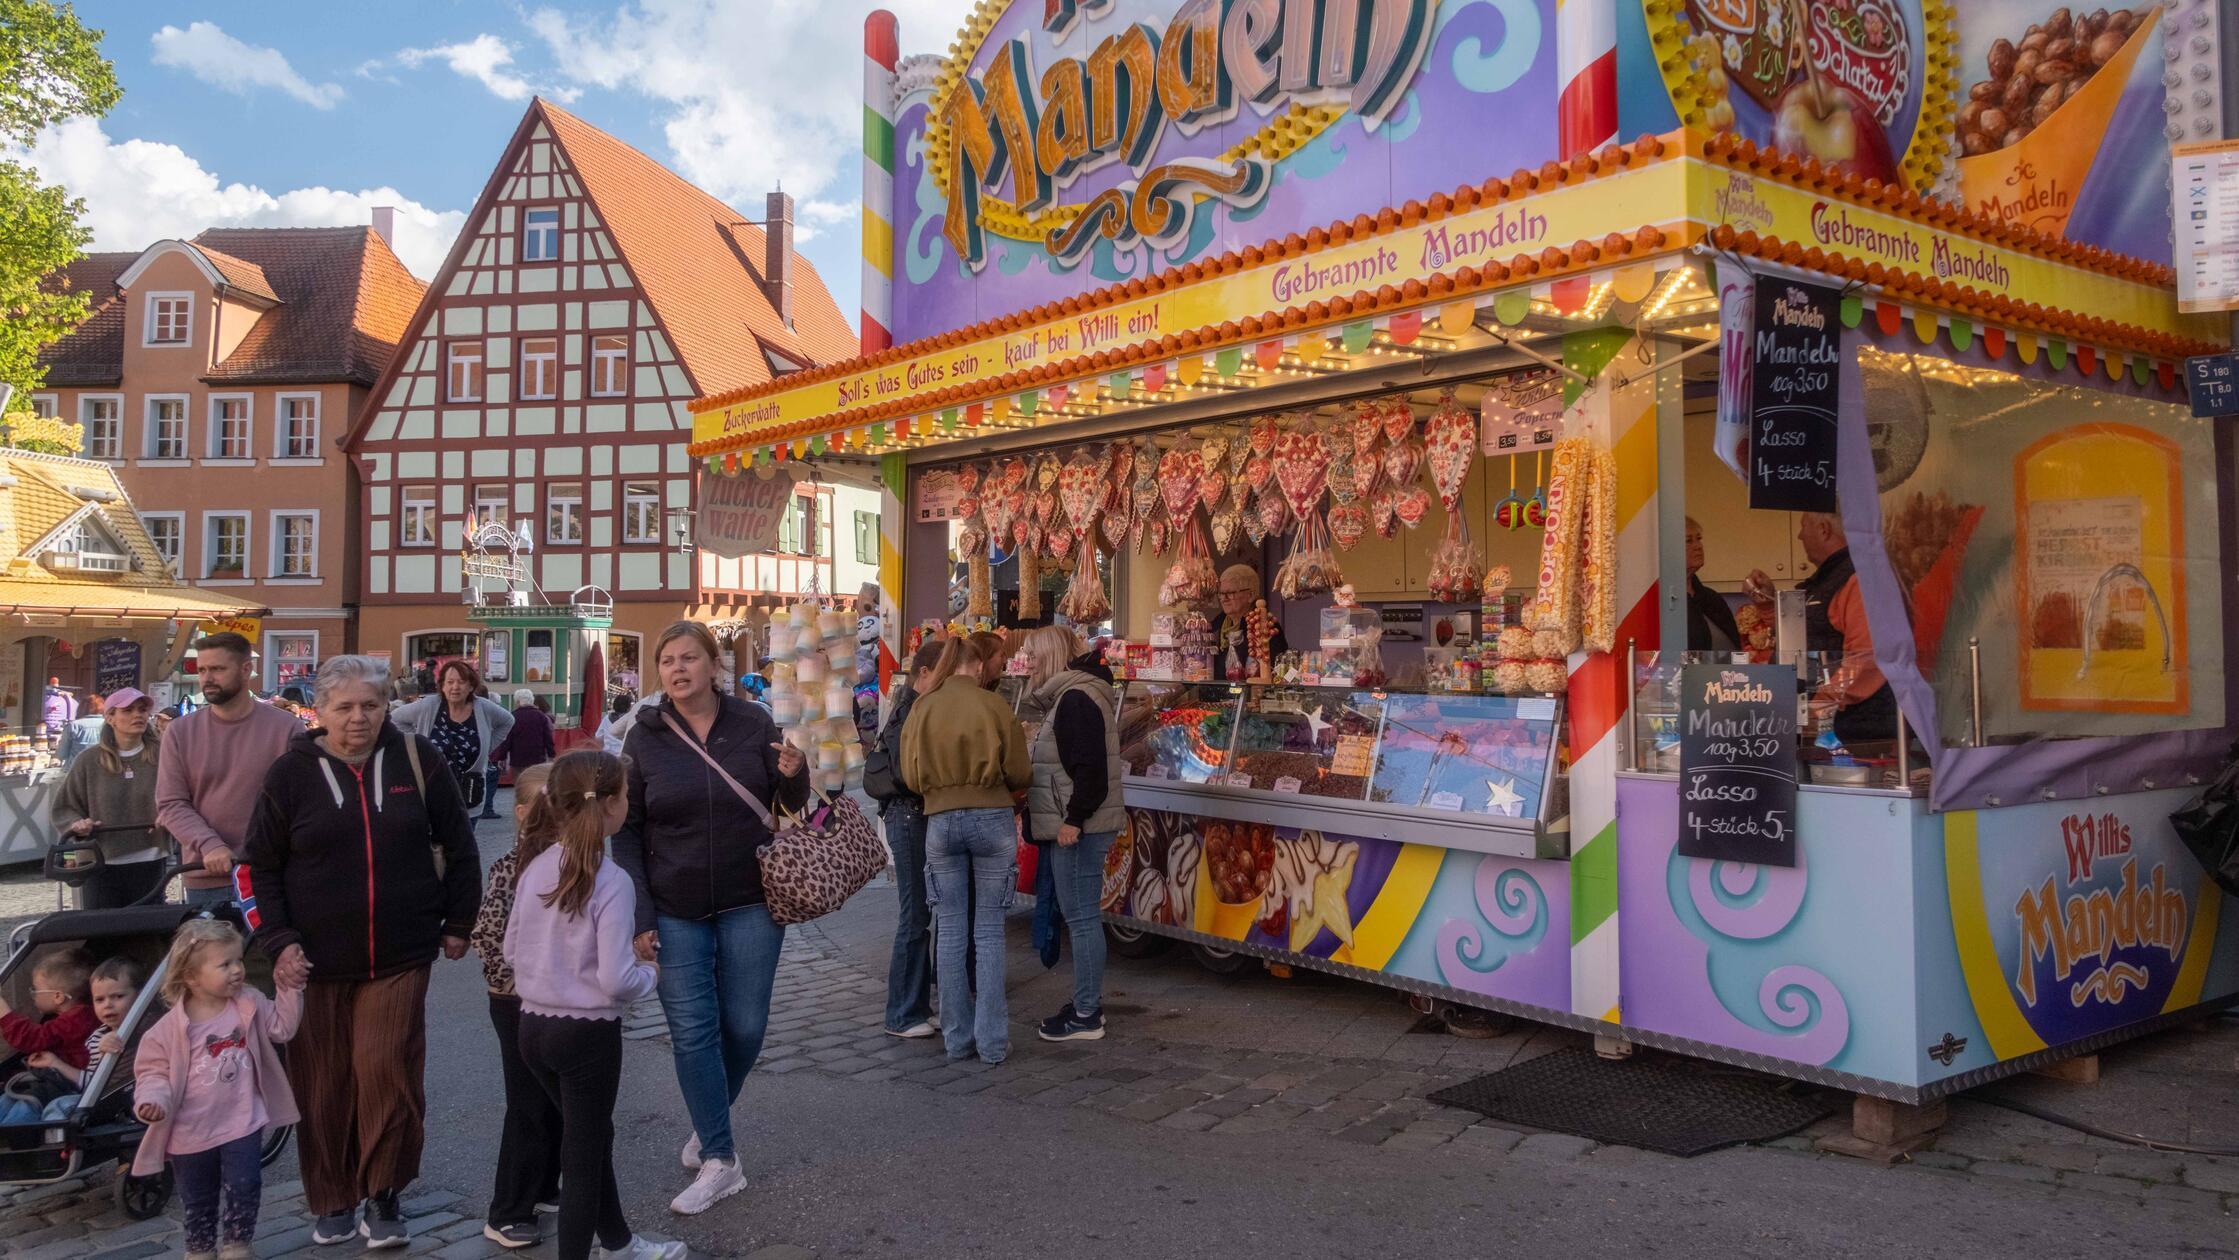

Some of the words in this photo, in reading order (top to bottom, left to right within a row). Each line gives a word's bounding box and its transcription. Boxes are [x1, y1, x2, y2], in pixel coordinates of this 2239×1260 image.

[1980, 179, 2068, 221] Mandeln
[1272, 245, 1399, 302] Gebrannte
[1419, 206, 1548, 271] Mandeln
[1811, 201, 1920, 263] Gebrannte
[1930, 234, 2010, 290] Mandeln
[1772, 298, 1825, 332] Mandeln
[876, 373, 901, 396] was
[907, 362, 945, 390] Gutes
[951, 353, 979, 377] sein
[1004, 332, 1040, 369] kauf
[1047, 329, 1069, 354] bei
[1078, 312, 1119, 350] Willi
[1127, 303, 1160, 334] ein!
[1756, 330, 1840, 364] Mandeln
[723, 402, 781, 433] Zuckerwatte
[1759, 419, 1806, 447] Lasso
[1757, 456, 1774, 487] 4
[1537, 474, 1567, 605] POPCORN
[1703, 681, 1773, 705] Mandeln
[1703, 742, 1738, 763] 100g
[1738, 738, 1780, 758] 3,50
[1685, 774, 1758, 802] Lasso
[1687, 811, 1709, 840] 4
[2060, 812, 2133, 888] Willis
[2015, 856, 2188, 1008] Mandeln
